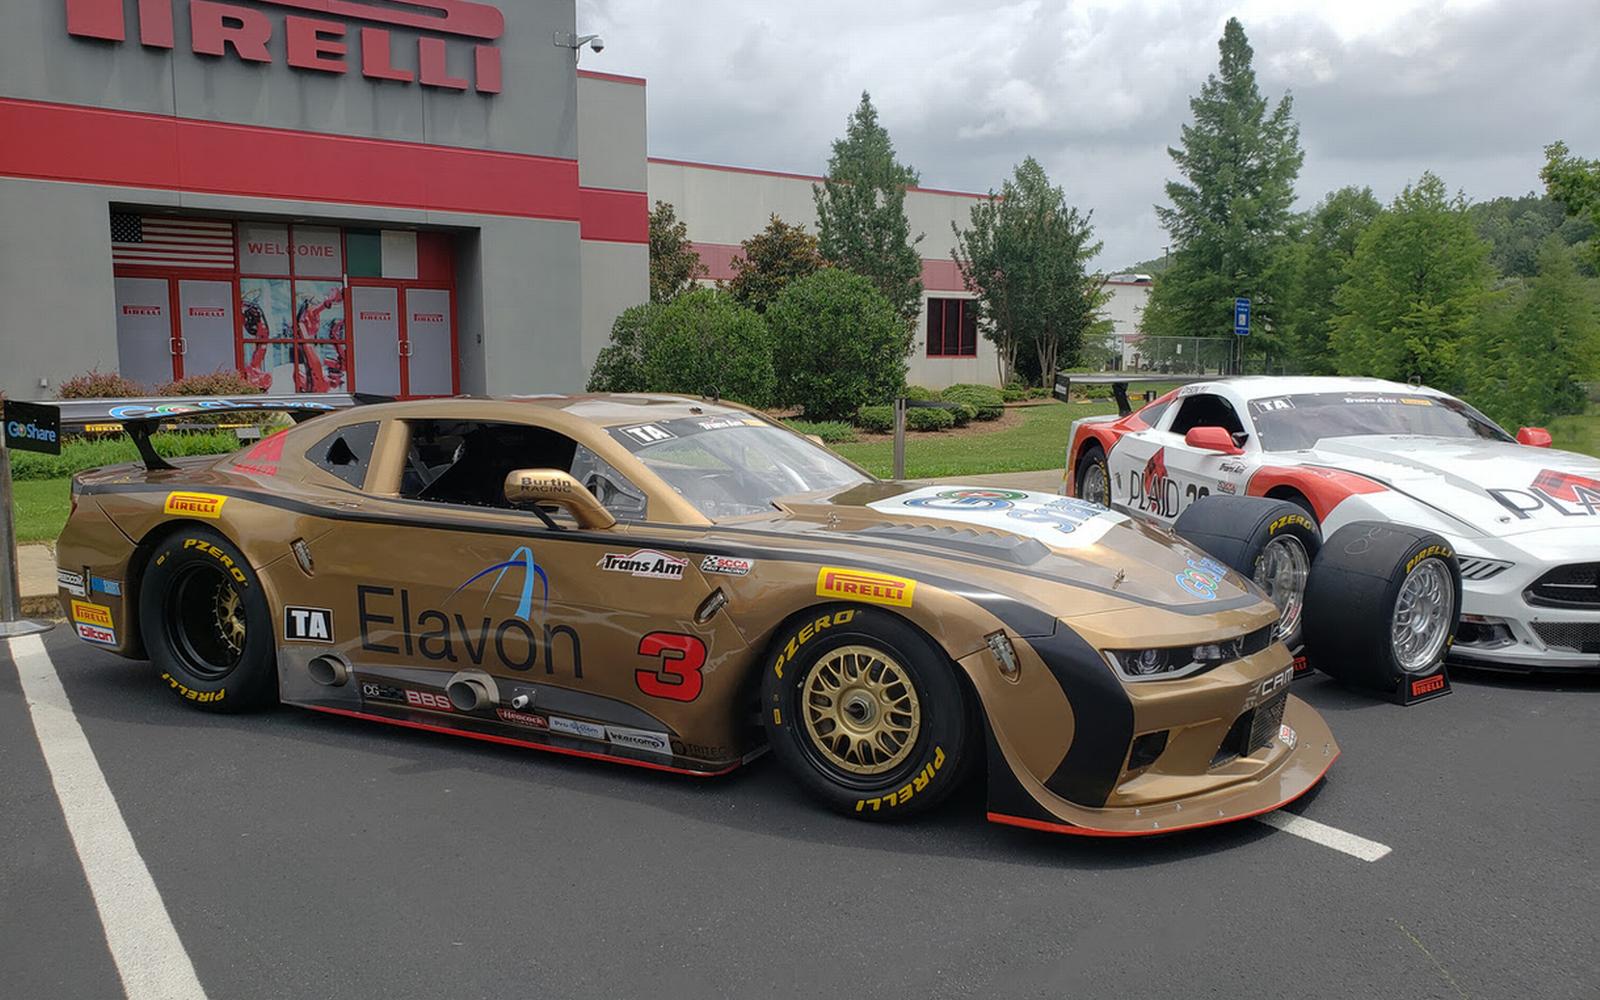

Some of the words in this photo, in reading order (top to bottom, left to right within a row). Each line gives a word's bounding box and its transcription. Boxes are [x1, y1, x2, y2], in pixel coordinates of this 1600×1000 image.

[247, 242, 334, 257] WELCOME
[1261, 400, 1290, 411] TA
[8, 421, 57, 442] GoShare
[627, 425, 671, 441] TA
[521, 477, 571, 487] Burtin
[521, 485, 571, 493] RACING
[169, 495, 219, 512] PIRELLI
[1127, 470, 1180, 518] PLAID
[604, 554, 653, 573] Trans
[653, 558, 683, 575] Am
[718, 558, 749, 569] SCCA
[1405, 545, 1453, 575] PIRELLI
[825, 572, 906, 600] PIRELLI
[75, 604, 109, 623] PIRELLI
[291, 610, 328, 639] TA
[356, 584, 584, 679] Elavon
[634, 630, 708, 703] 3
[161, 672, 225, 702] PIRELLI
[1412, 674, 1444, 697] PIRELLI
[405, 690, 451, 709] BBS
[855, 746, 945, 812] PIRELLI
